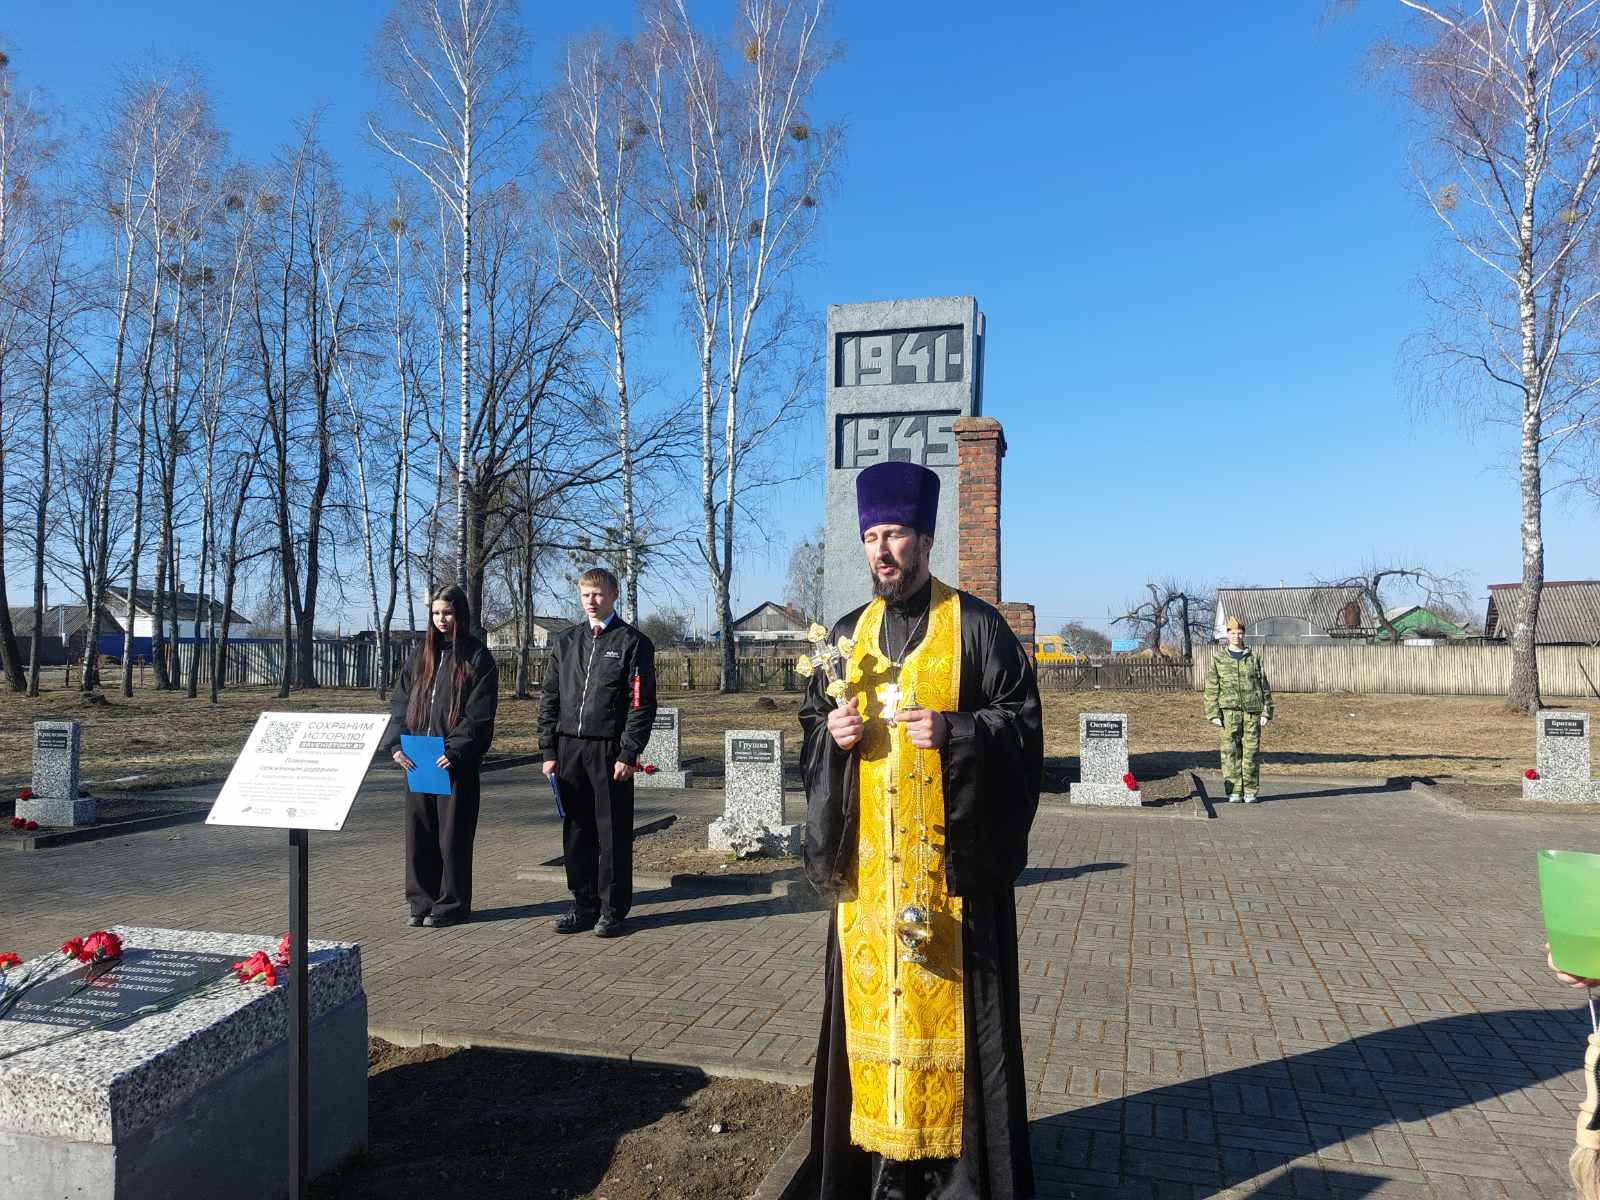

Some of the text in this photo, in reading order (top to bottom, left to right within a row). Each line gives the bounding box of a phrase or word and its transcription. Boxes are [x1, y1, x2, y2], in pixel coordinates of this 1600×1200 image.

[843, 416, 959, 468] 1945
[308, 721, 375, 730] СОХРАНИМ
[1090, 721, 1119, 729] Октябрь
[302, 732, 365, 741] ИСТОРИЮ!
